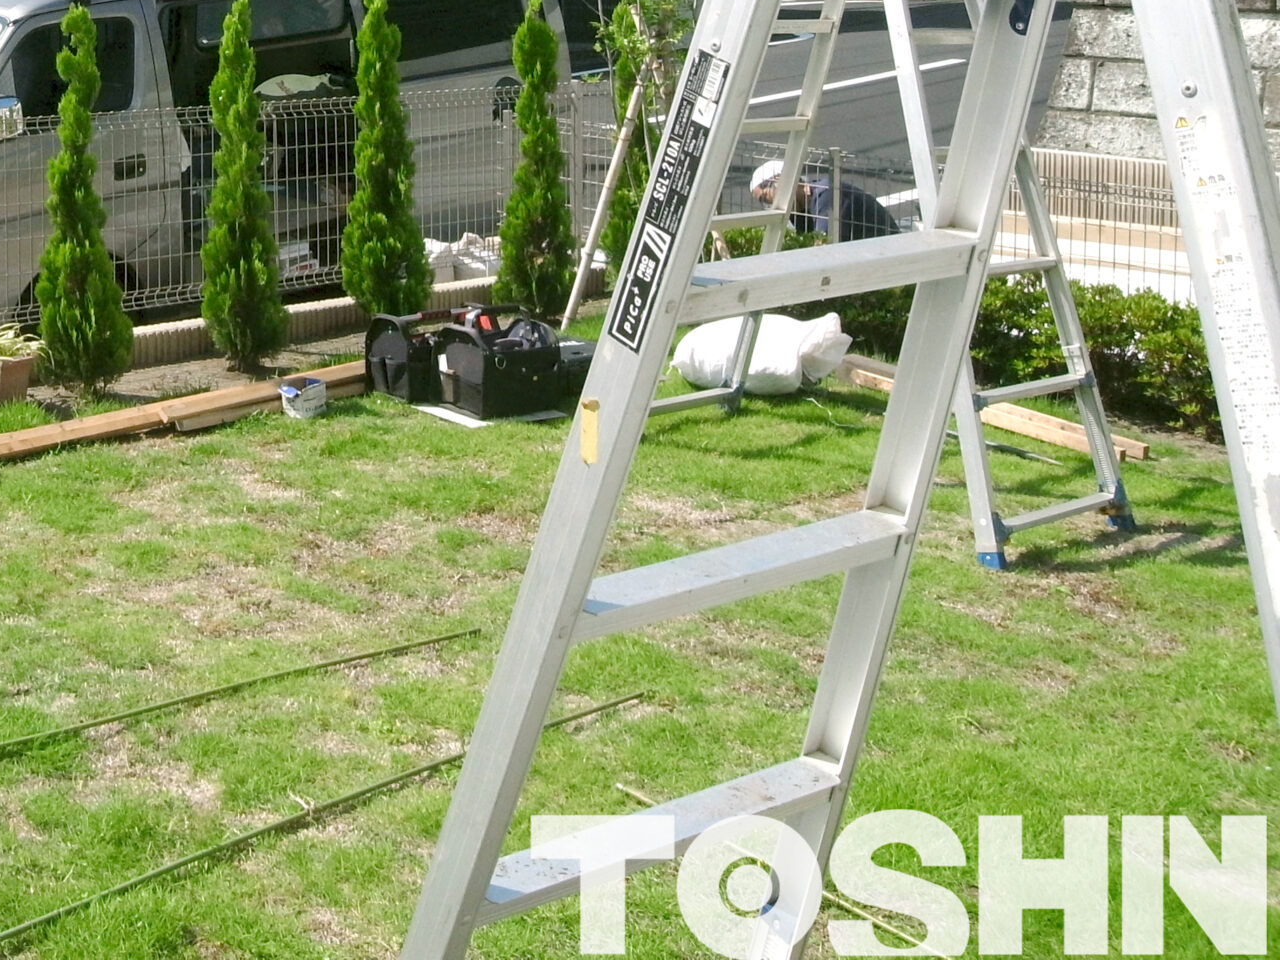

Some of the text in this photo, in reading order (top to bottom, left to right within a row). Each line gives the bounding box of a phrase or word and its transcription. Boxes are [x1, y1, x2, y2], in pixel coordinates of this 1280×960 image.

[653, 139, 680, 201] SCL-210A
[636, 255, 649, 279] PRO
[643, 259, 656, 282] USE
